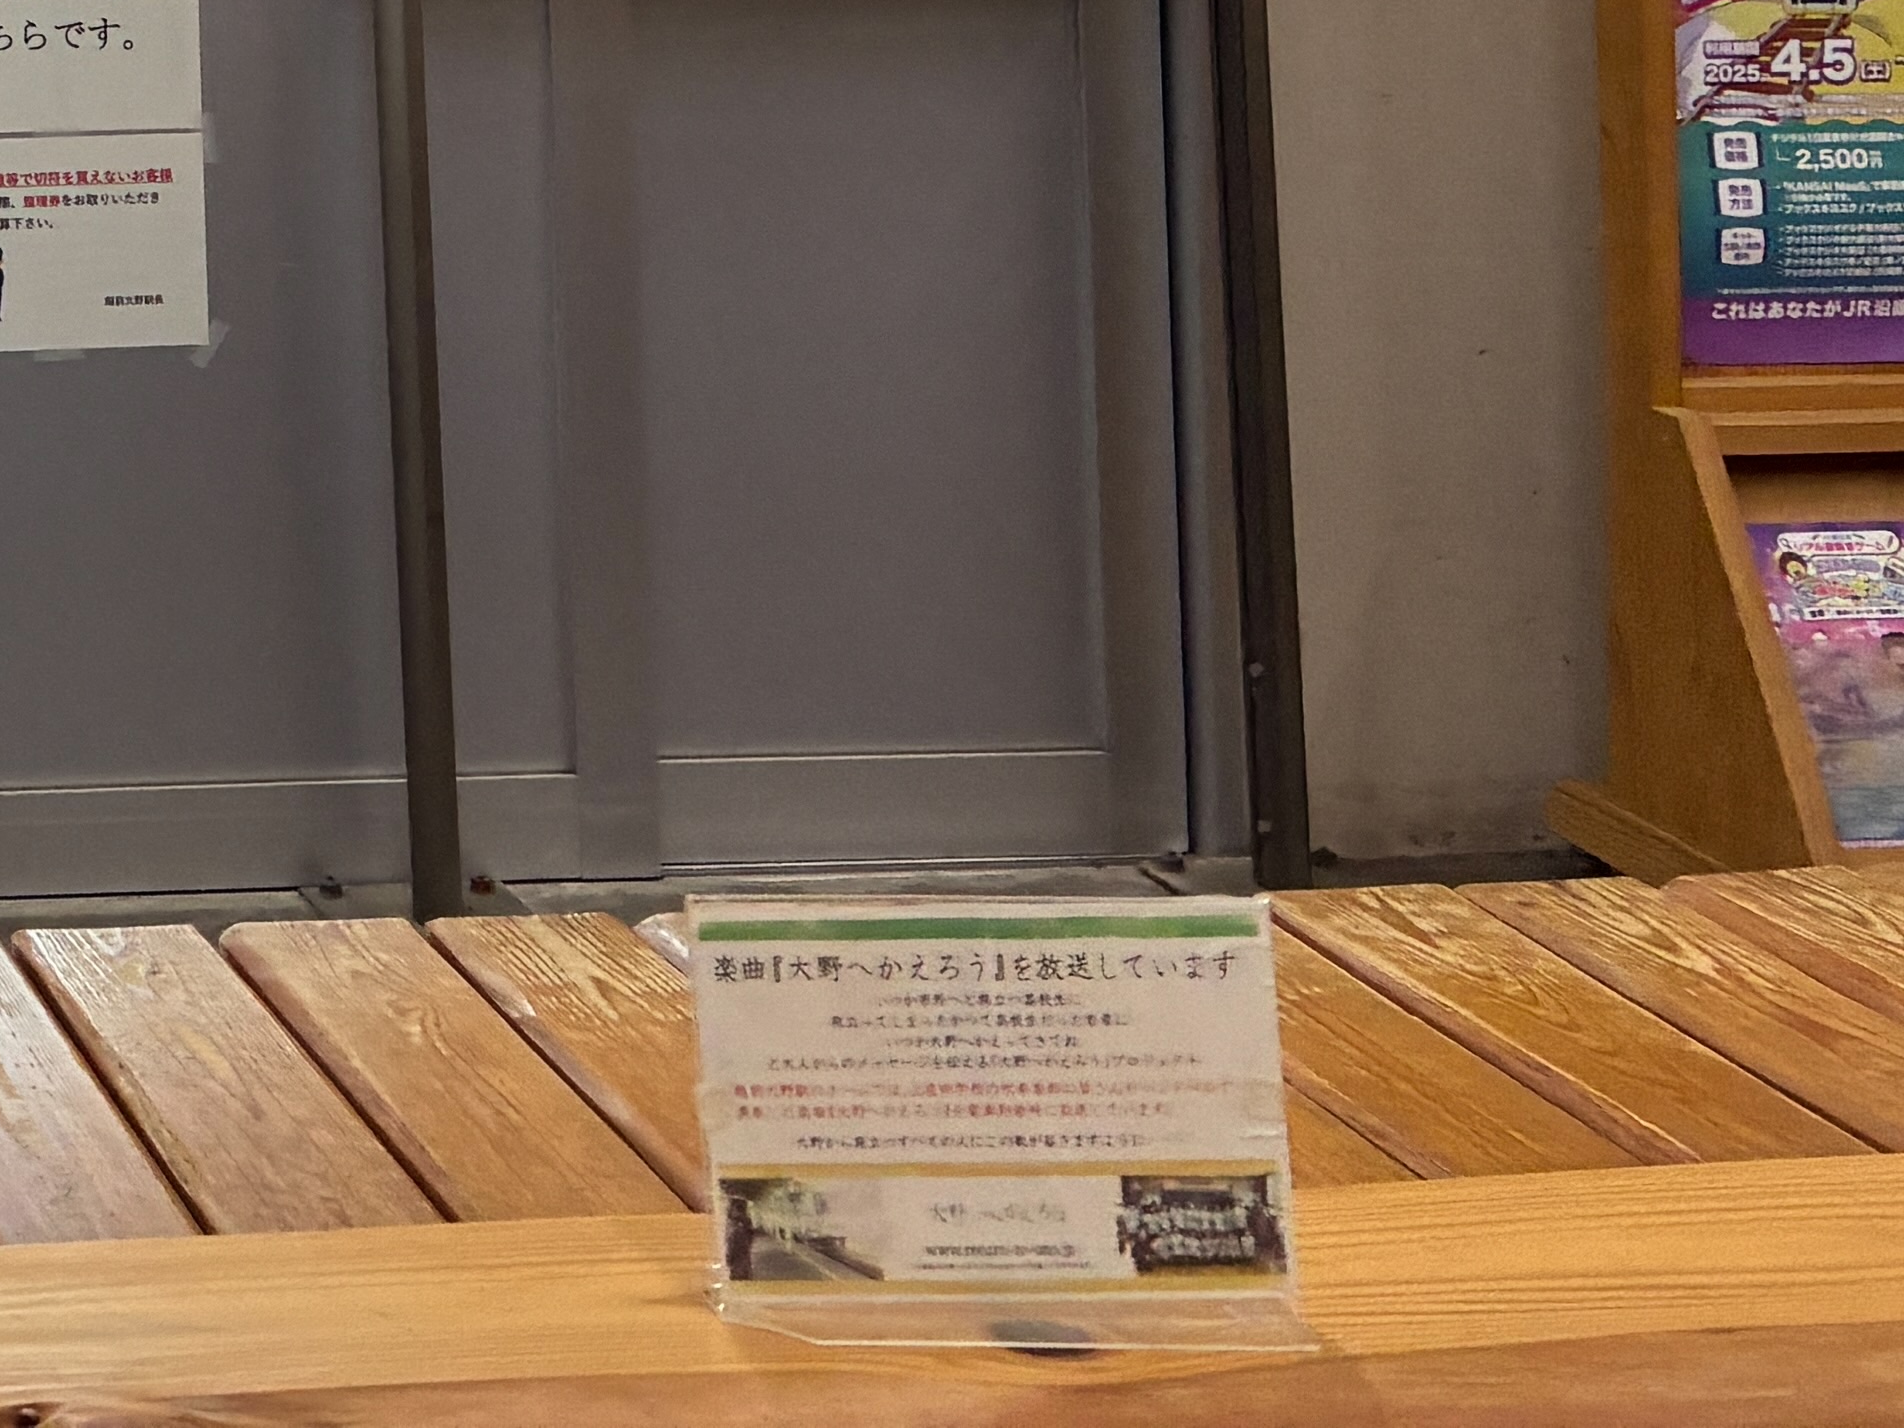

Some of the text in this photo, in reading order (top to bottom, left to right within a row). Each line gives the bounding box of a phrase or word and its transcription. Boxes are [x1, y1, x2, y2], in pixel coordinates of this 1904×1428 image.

[713, 952, 1236, 982] 楽曲『大野へかえろう』を放送しています
